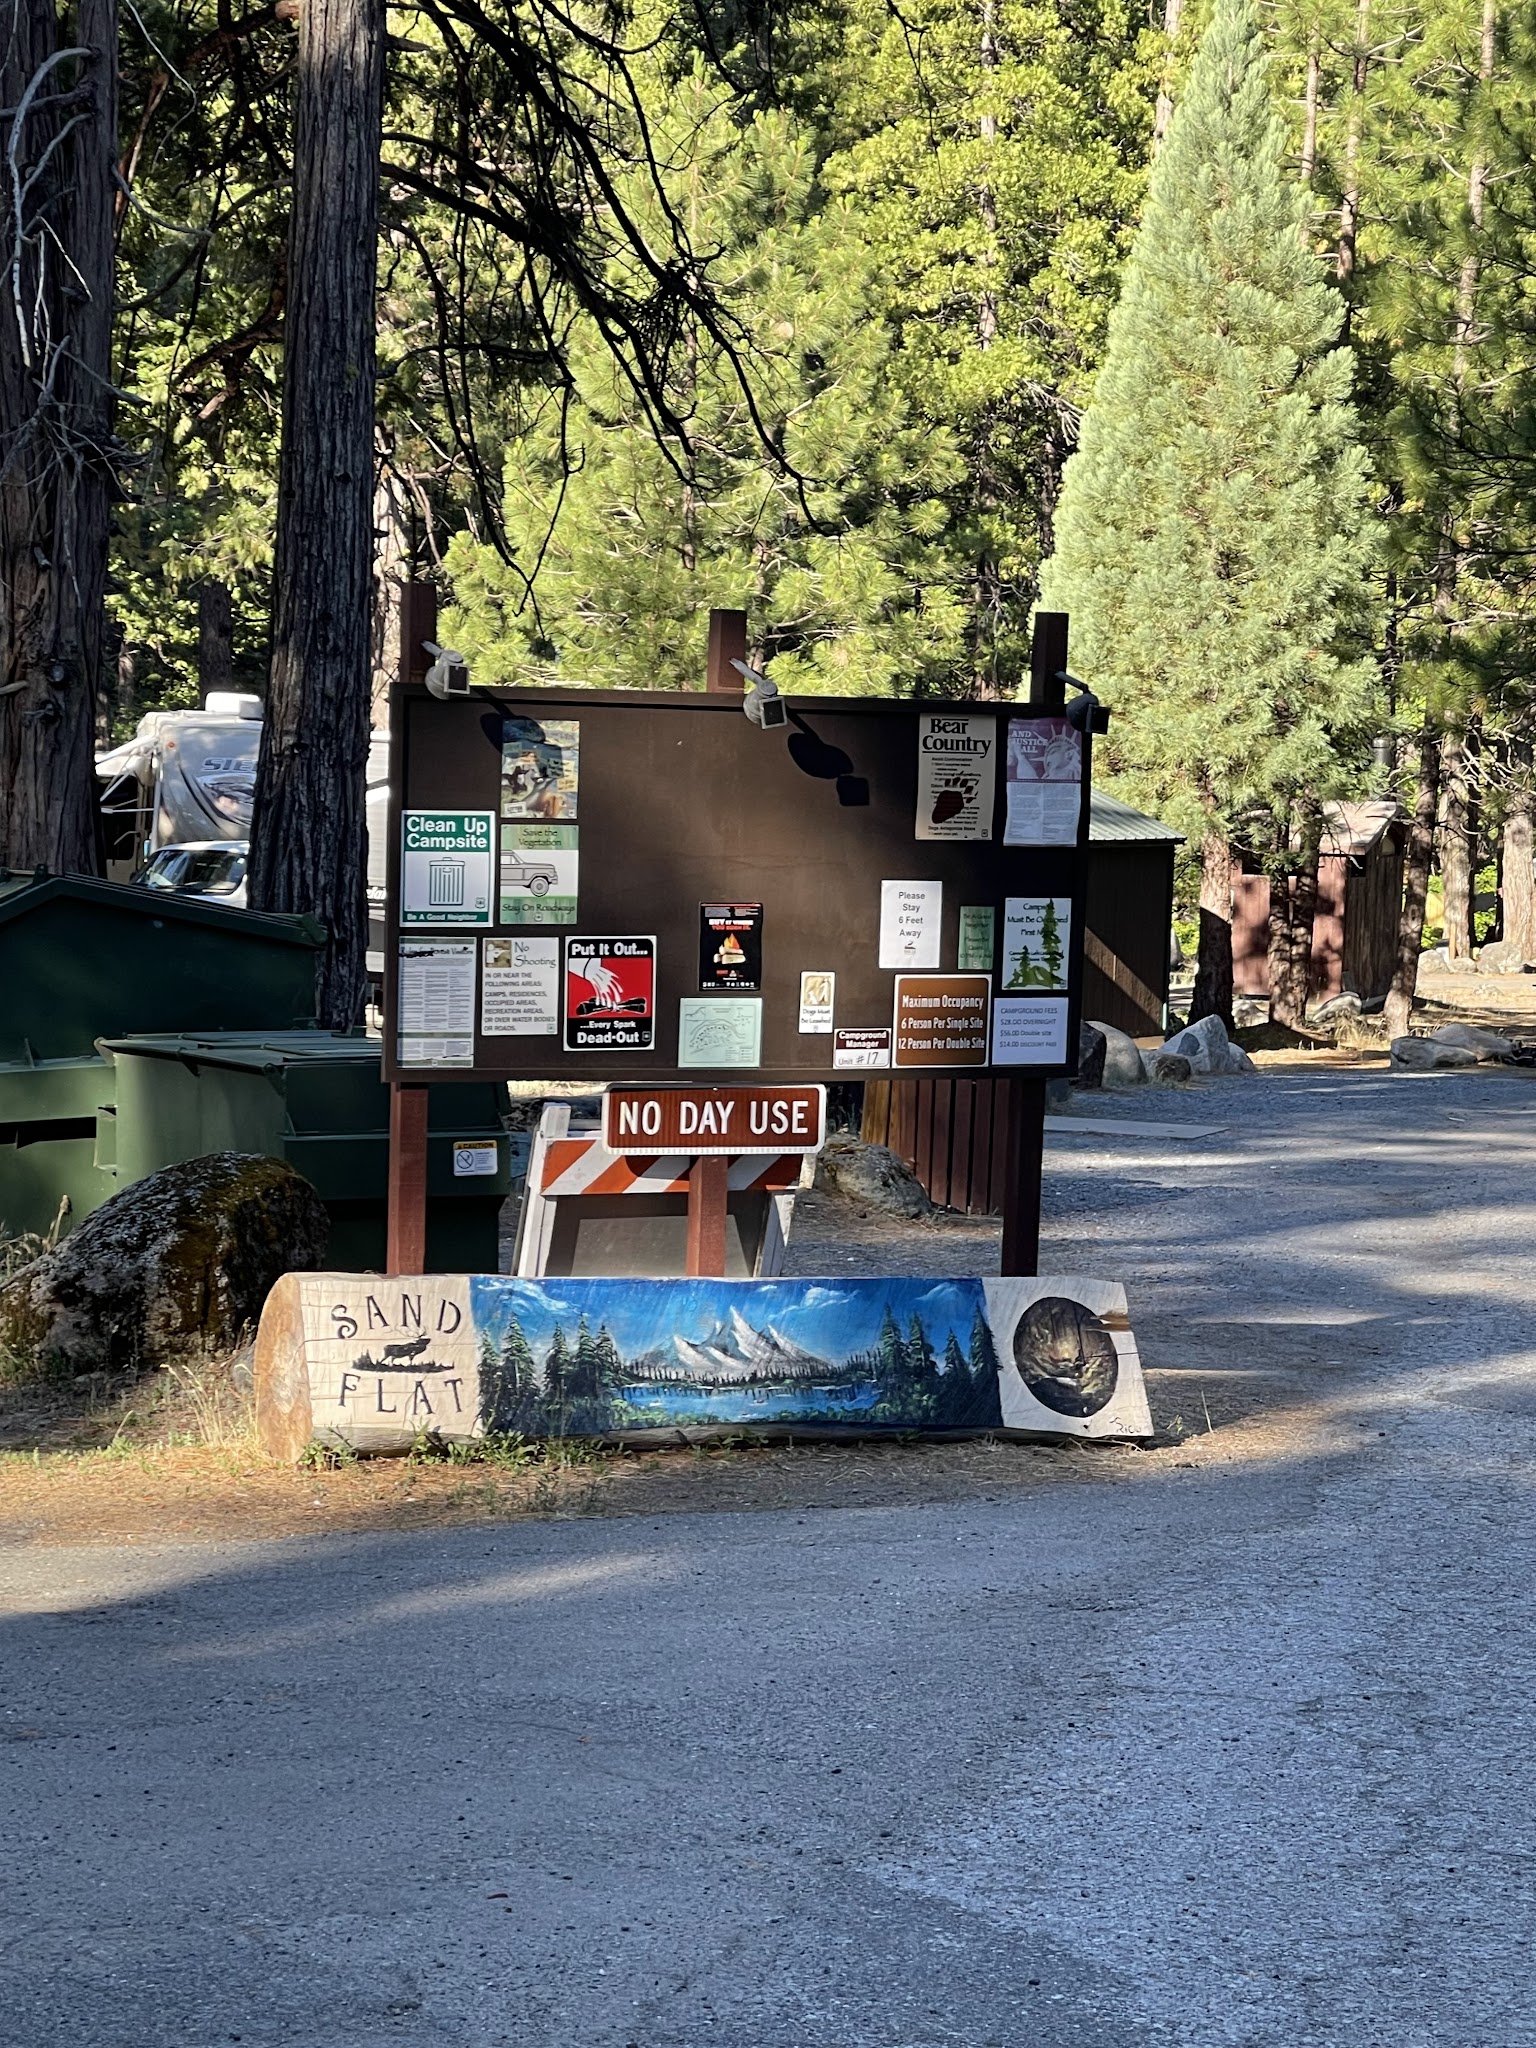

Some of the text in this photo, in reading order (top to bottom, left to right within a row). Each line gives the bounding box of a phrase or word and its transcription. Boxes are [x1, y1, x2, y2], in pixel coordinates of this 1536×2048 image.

[930, 718, 969, 734] Bear
[1011, 730, 1032, 738] AND
[922, 735, 992, 759] Country
[1021, 745, 1038, 753] ALL
[202, 757, 258, 771] SIE
[406, 816, 487, 835] Clean Up
[522, 826, 558, 836] Save the
[406, 833, 487, 850] Campsite
[518, 838, 562, 849] Vegetation
[898, 891, 926, 900] Please
[502, 900, 576, 915] Stay On Roadways
[902, 903, 921, 913] Stay
[898, 916, 924, 924] 6 Feet
[1025, 915, 1035, 923] Be
[899, 929, 922, 939] Away
[514, 941, 530, 953] No
[571, 941, 649, 956] Put It Out...
[513, 954, 557, 968] Shooting
[902, 994, 984, 1010] Maximum Occupancy
[613, 1020, 636, 1029] Spark
[901, 1017, 984, 1032] 6 Person Per Single Site
[576, 1031, 640, 1044] Dead-Out
[838, 1031, 887, 1040] Campground
[845, 1040, 880, 1048] Manager
[898, 1037, 985, 1050] 12 Person Per Double Site
[619, 1101, 809, 1135] NO DAY USE
[331, 1294, 462, 1339] SAND
[338, 1372, 463, 1415] FLAT
